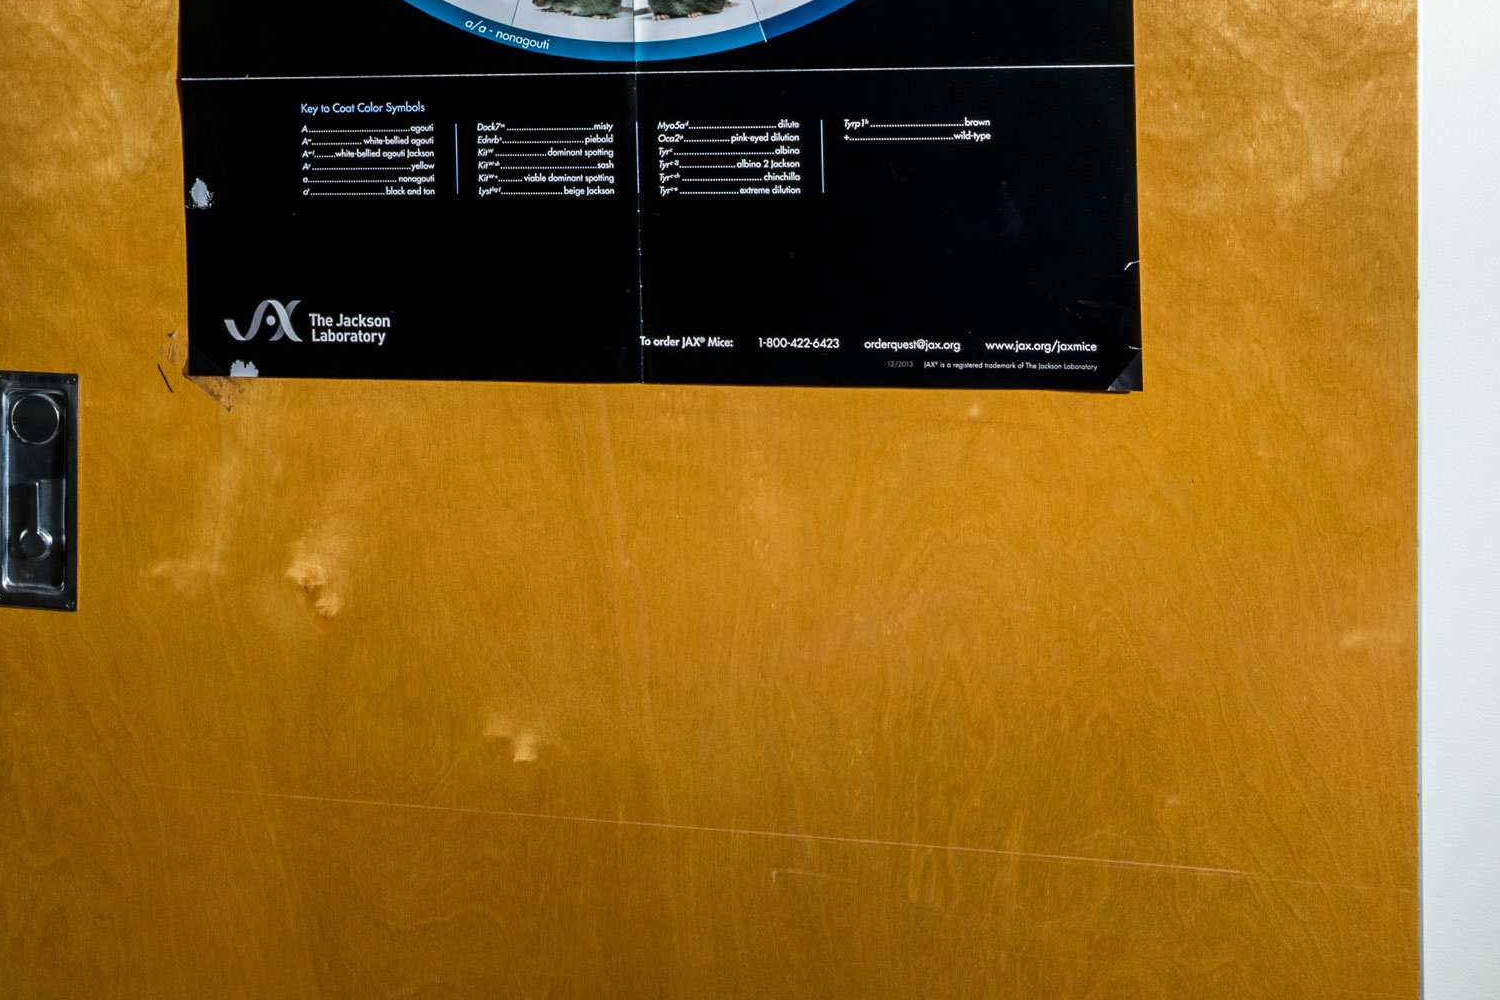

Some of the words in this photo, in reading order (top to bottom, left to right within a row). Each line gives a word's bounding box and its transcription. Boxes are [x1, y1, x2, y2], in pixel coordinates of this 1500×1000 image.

[465, 20, 487, 33] a/a
[495, 30, 551, 50] nonagouti
[301, 104, 318, 116] Key
[321, 105, 330, 113] to
[333, 103, 354, 113] Coat
[357, 102, 383, 112] Color
[386, 101, 425, 115] Symbols
[730, 132, 769, 144] pink-eyed
[770, 132, 800, 142] dilution
[334, 148, 381, 158] white-bellied
[382, 148, 406, 159] agouti
[407, 148, 435, 159] Jackson
[547, 147, 582, 157] dominant
[584, 148, 614, 158] spotting
[385, 186, 405, 195] black
[407, 186, 421, 195] and
[423, 186, 435, 195] tan
[563, 186, 585, 196] beige
[586, 185, 615, 196] Jackson
[739, 186, 770, 194] extreme
[771, 184, 801, 194] dilution
[309, 314, 333, 326] The
[336, 314, 390, 327] Jackson
[312, 329, 385, 345] Laboratory
[640, 336, 651, 346] To
[653, 335, 680, 347] order
[707, 336, 734, 347] Mice:
[759, 338, 839, 348] 1-800-422-6423
[864, 338, 960, 352] orderquest@jax.org
[985, 340, 1097, 353] www.jax.org/jaxmice
